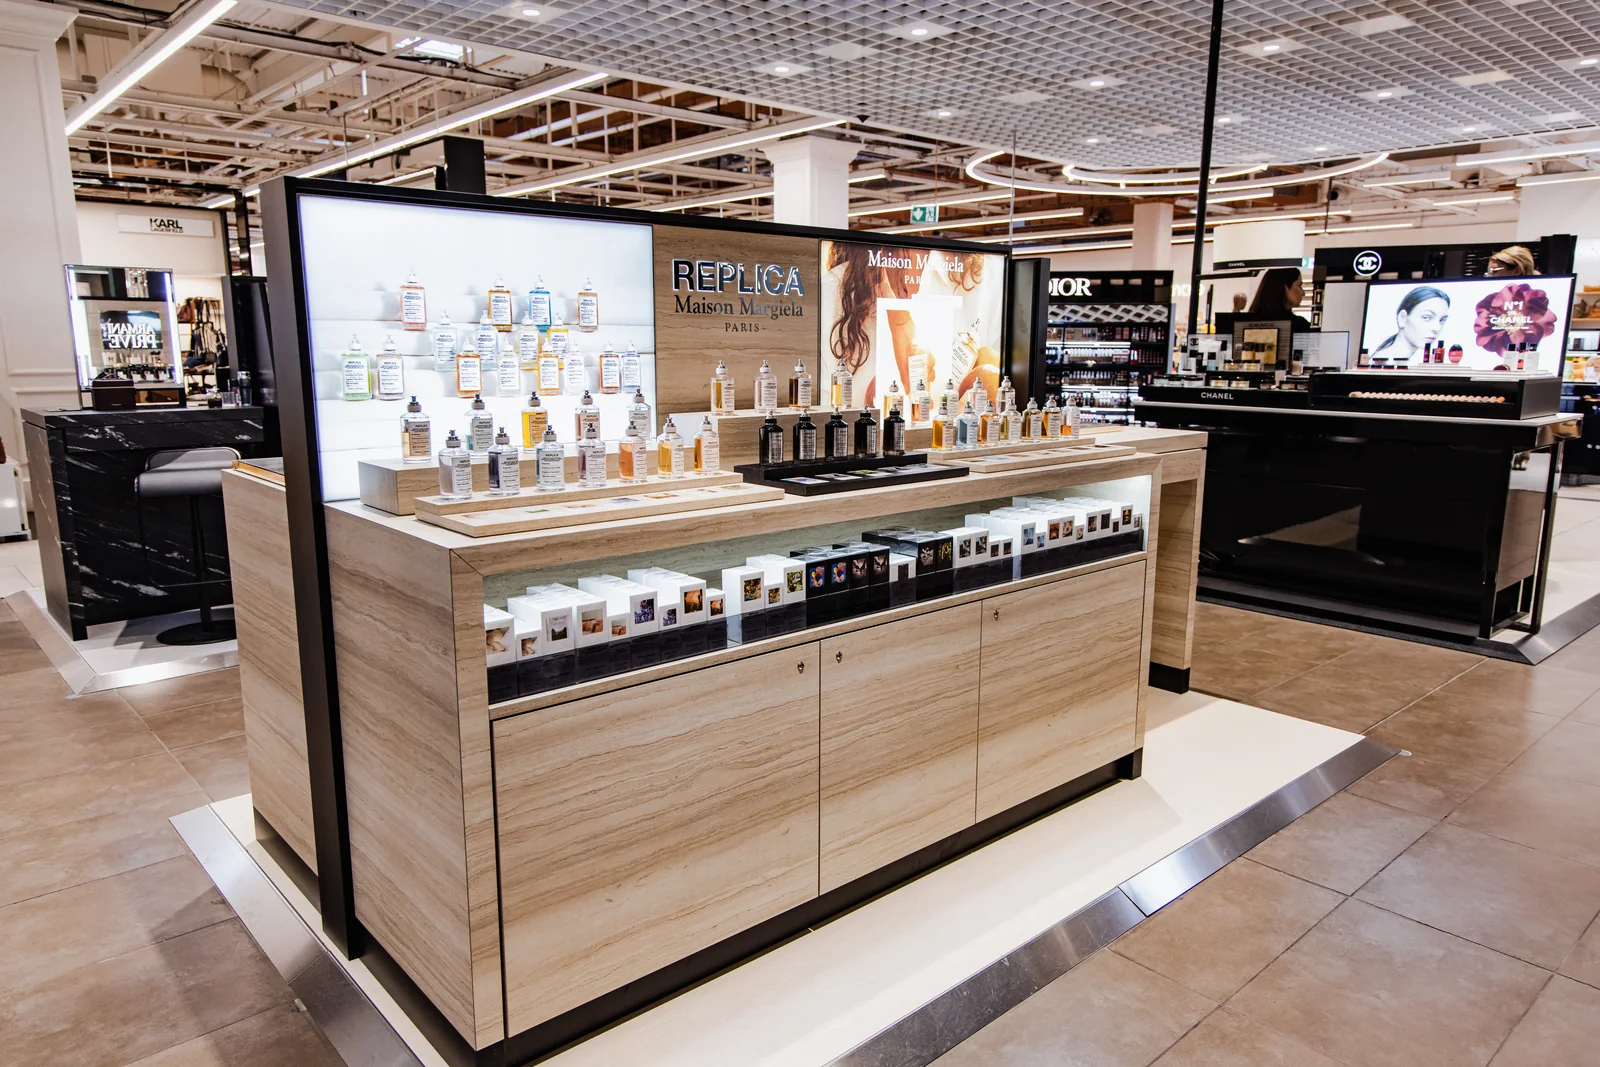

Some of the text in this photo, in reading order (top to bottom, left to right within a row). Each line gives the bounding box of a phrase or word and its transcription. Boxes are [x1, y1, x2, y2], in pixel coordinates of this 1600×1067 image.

[150, 218, 183, 229] KARL
[868, 250, 964, 273] Maison Miela
[672, 259, 805, 296] REPLICA
[674, 295, 803, 320] Maison Margiela
[1490, 316, 1533, 324] CHANEL
[725, 322, 760, 333] PARIS
[1200, 391, 1234, 400] CHANEL
